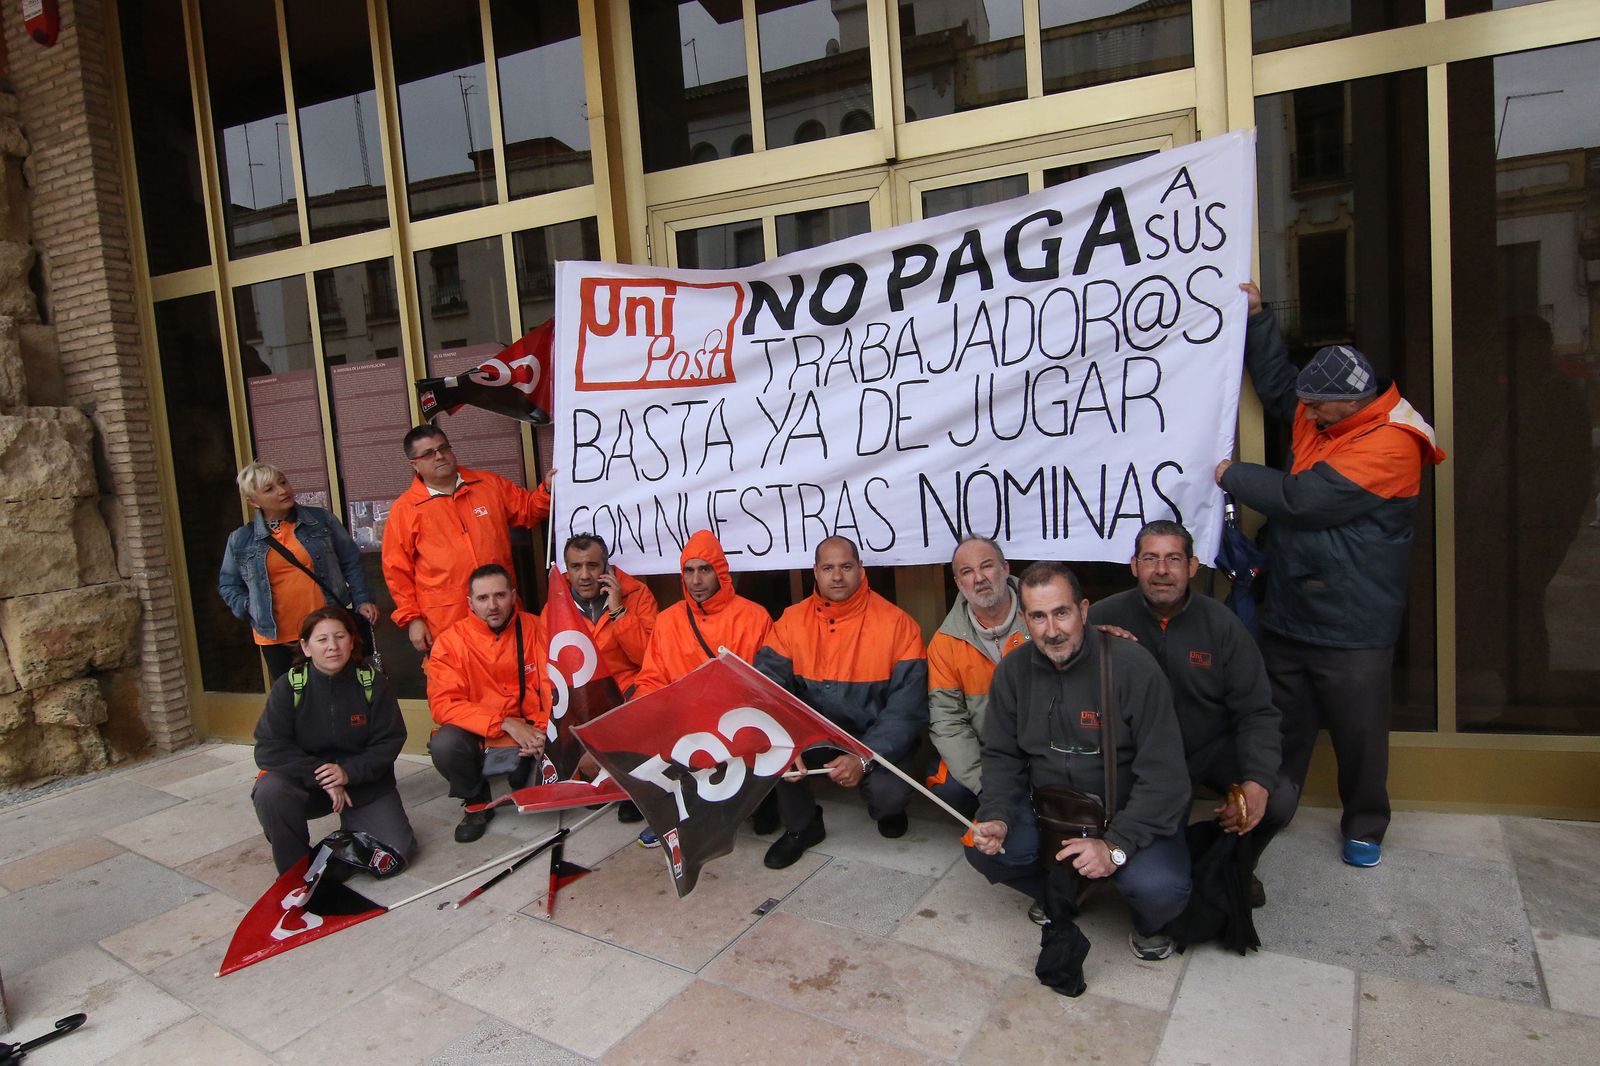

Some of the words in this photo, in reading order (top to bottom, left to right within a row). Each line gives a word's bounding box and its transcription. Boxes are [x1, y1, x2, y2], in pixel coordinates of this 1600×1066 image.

[1160, 166, 1197, 204] A
[742, 263, 867, 336] NO
[887, 187, 1141, 312] PAGA
[1145, 202, 1226, 260] SUS
[582, 278, 677, 337] Uni
[750, 265, 1223, 394] TRABAJADOR@S
[638, 329, 728, 381] Post
[572, 398, 734, 483] BASTA
[756, 390, 827, 468] YA
[857, 379, 930, 457] DE
[948, 357, 1165, 447] JUGAR
[655, 477, 895, 556] NUESTRAS
[918, 461, 1184, 548] NÓMINAS
